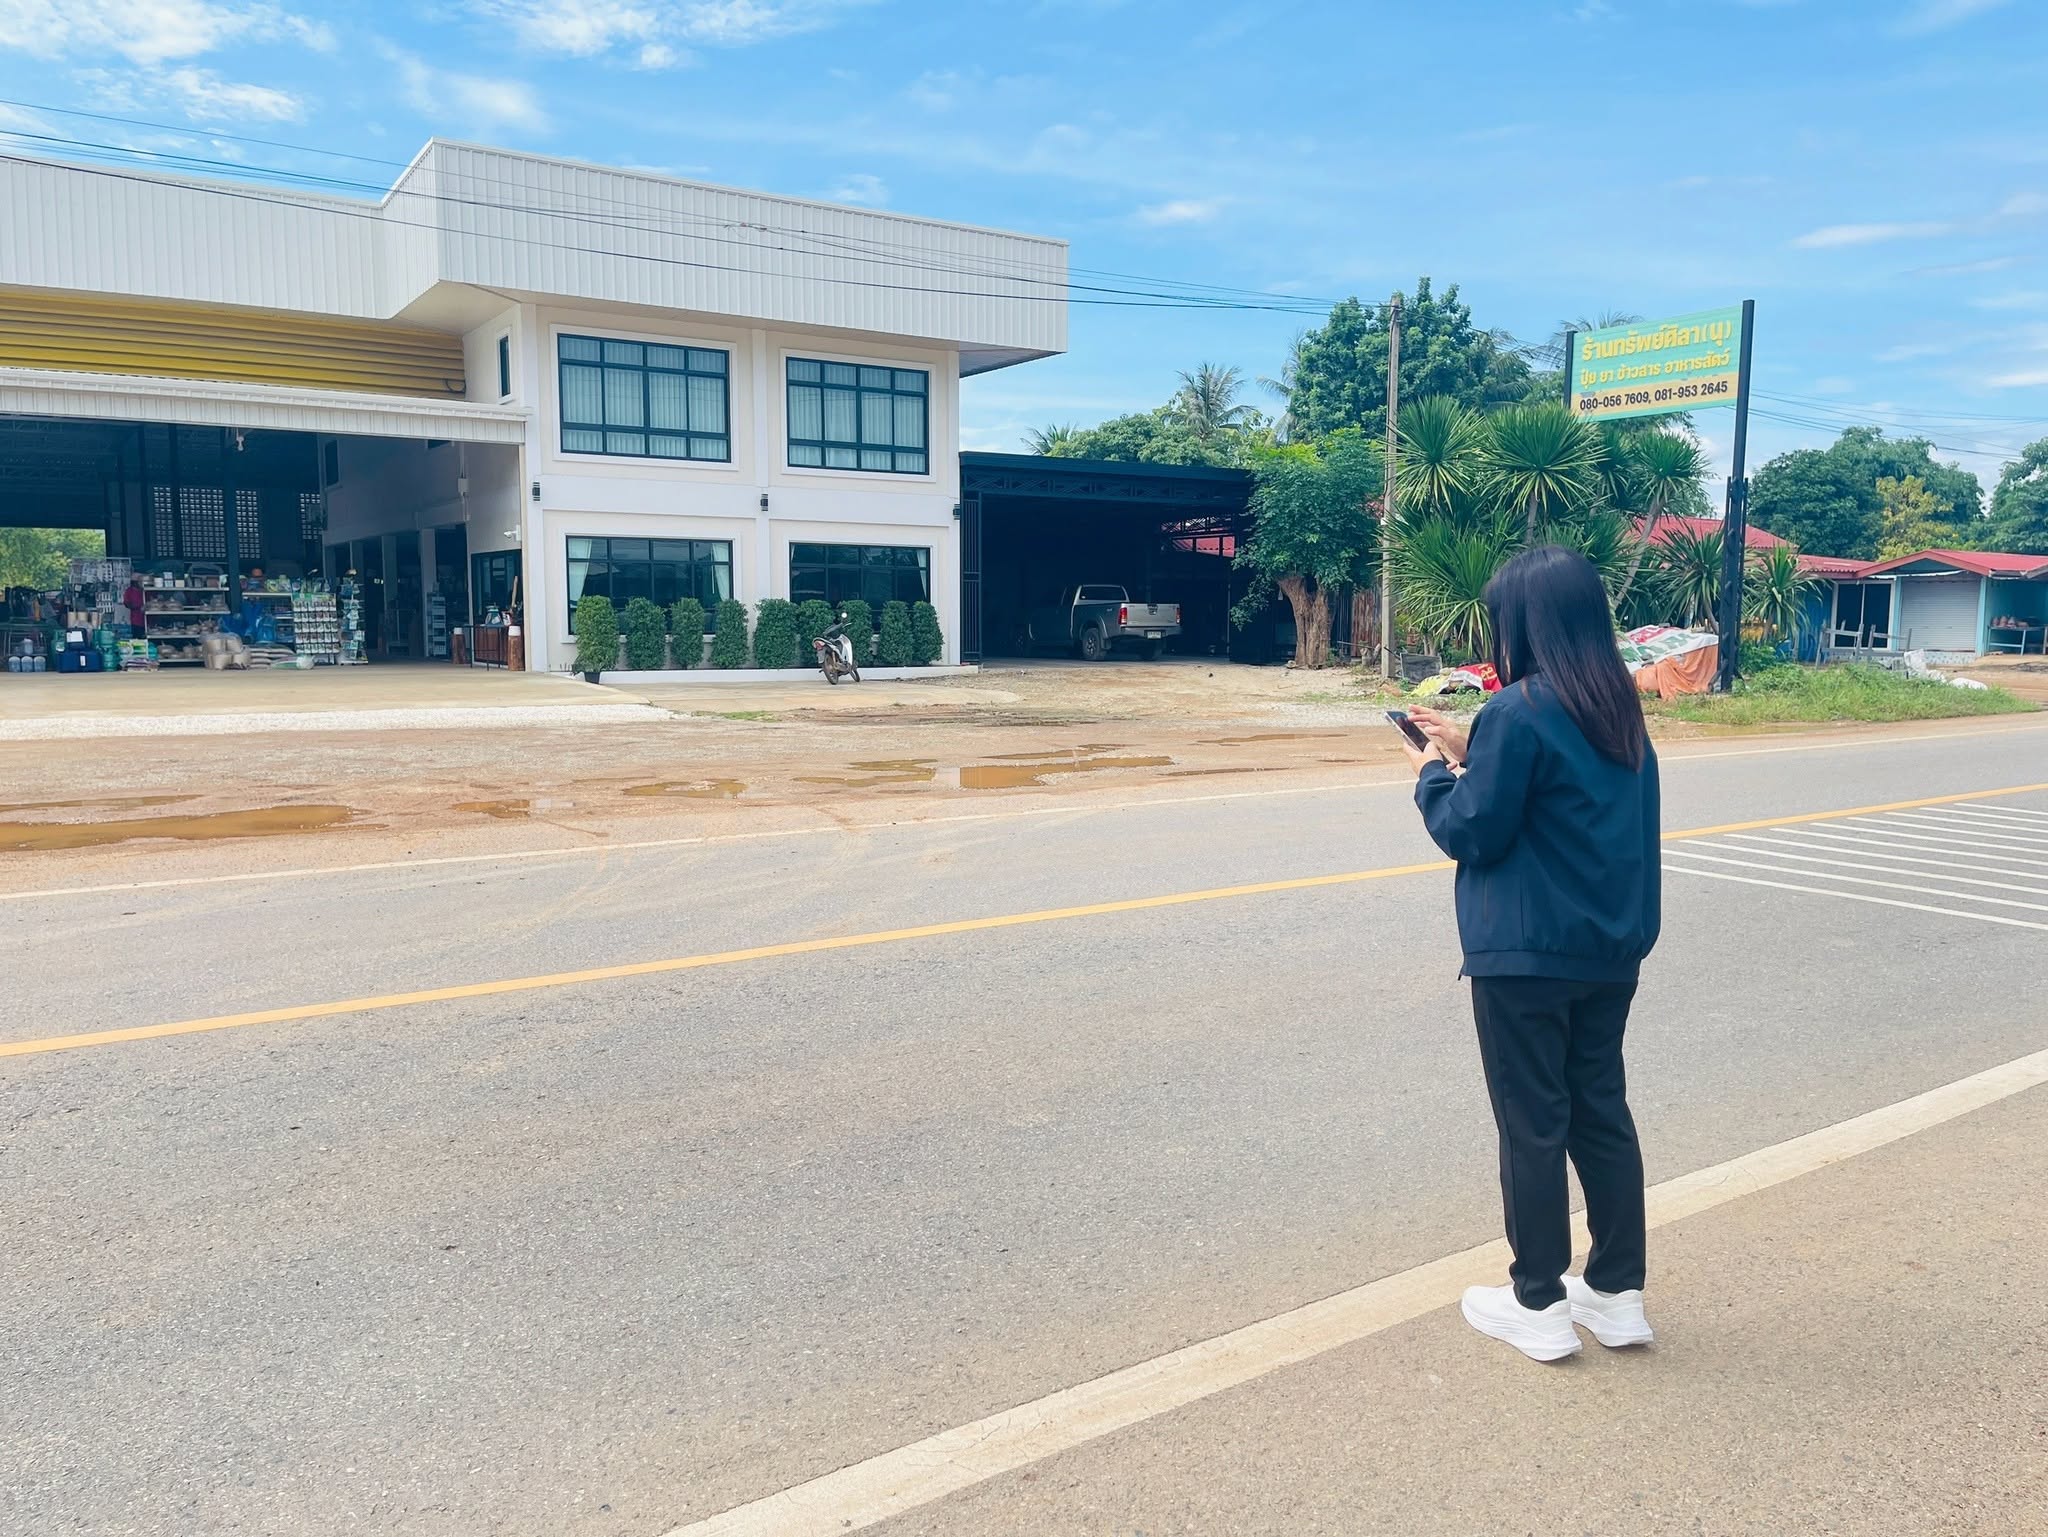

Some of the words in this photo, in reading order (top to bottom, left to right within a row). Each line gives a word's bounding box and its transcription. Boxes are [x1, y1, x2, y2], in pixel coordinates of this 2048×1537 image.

[1600, 370, 1614, 383] ยา
[1617, 364, 1661, 380] ข้าวสาร
[1665, 348, 1730, 374] อาหารสัตว์
[1580, 395, 1622, 410] 080-056
[1625, 392, 1651, 404] 7609,
[1654, 385, 1697, 401] 081-953
[1700, 381, 1728, 396] 2645
